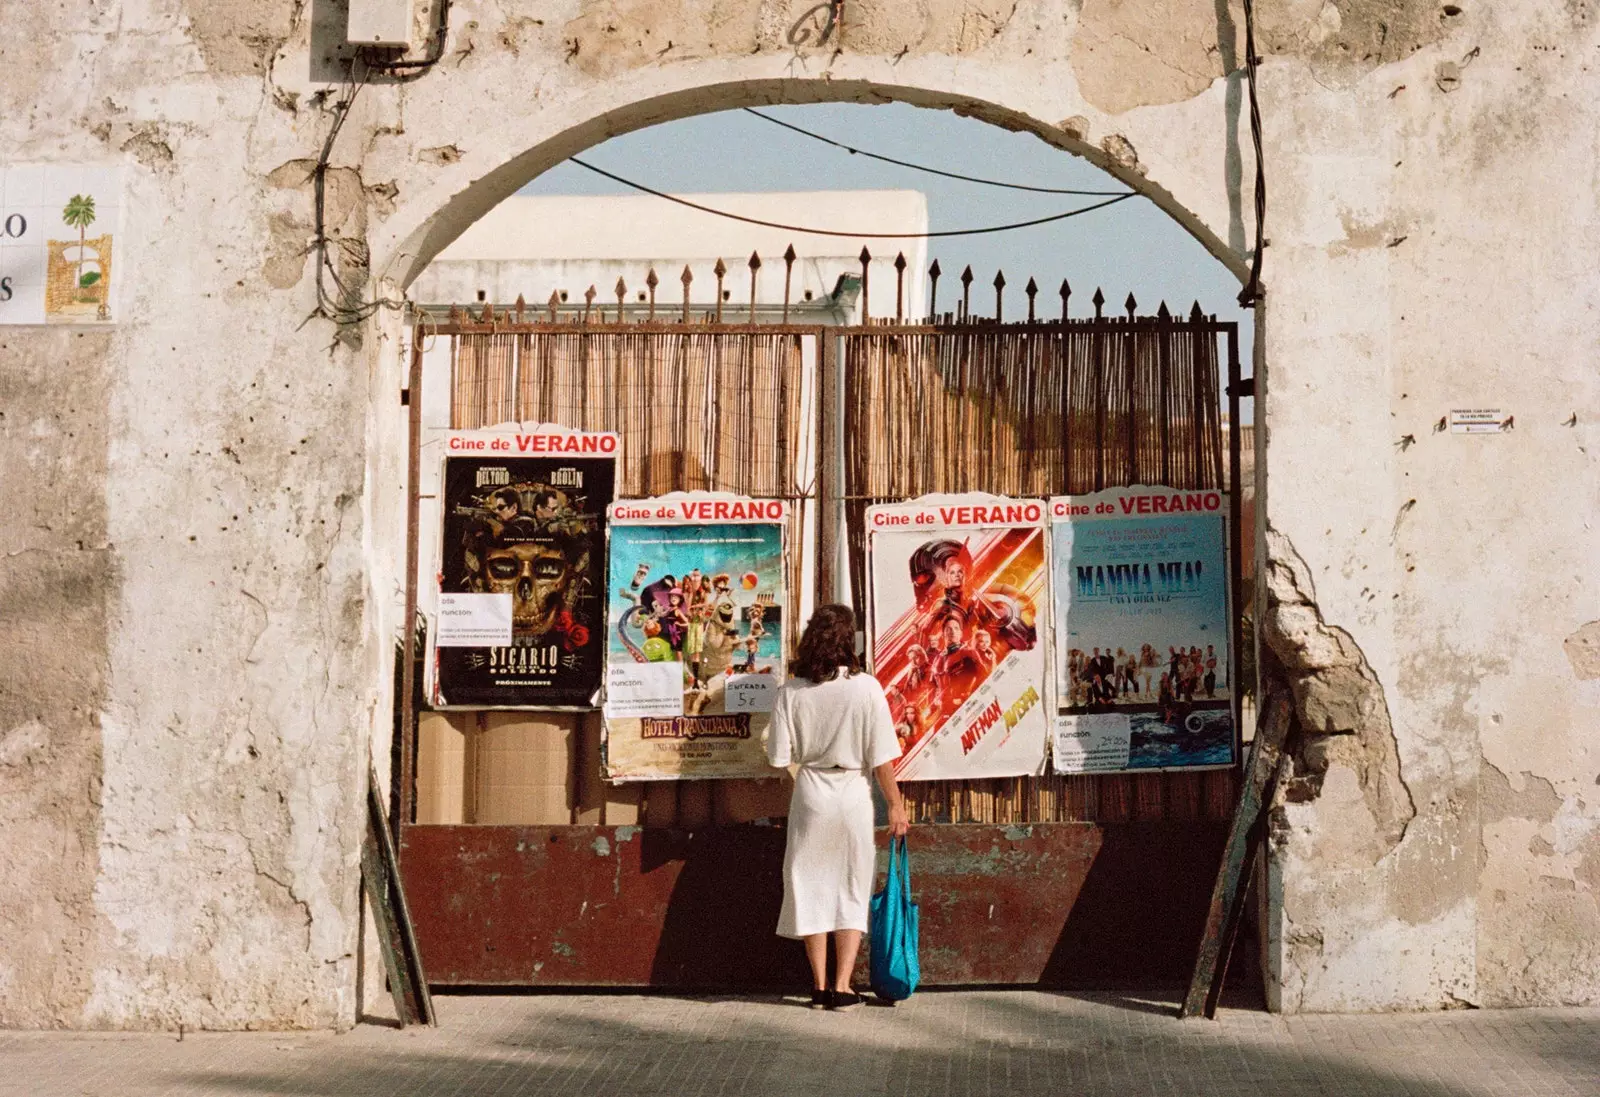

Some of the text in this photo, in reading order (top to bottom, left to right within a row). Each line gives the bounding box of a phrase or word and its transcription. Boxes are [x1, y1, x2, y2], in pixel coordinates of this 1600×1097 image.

[0, 213, 27, 238] O
[449, 434, 617, 453] Cine de VERANO
[476, 470, 510, 488] DEL TORO
[551, 471, 583, 488] BROLIN
[614, 501, 783, 520] Cine de VERANO
[874, 504, 1041, 526] Cine de VERANO
[1054, 493, 1221, 516] Cine de VERANO
[1076, 563, 1153, 597] MAMMA
[490, 645, 558, 667] SICARIO
[727, 682, 766, 690] ENTRADA
[643, 718, 676, 737] HOTEL
[737, 714, 747, 737] 3
[961, 695, 1002, 756] ANT-MAN
